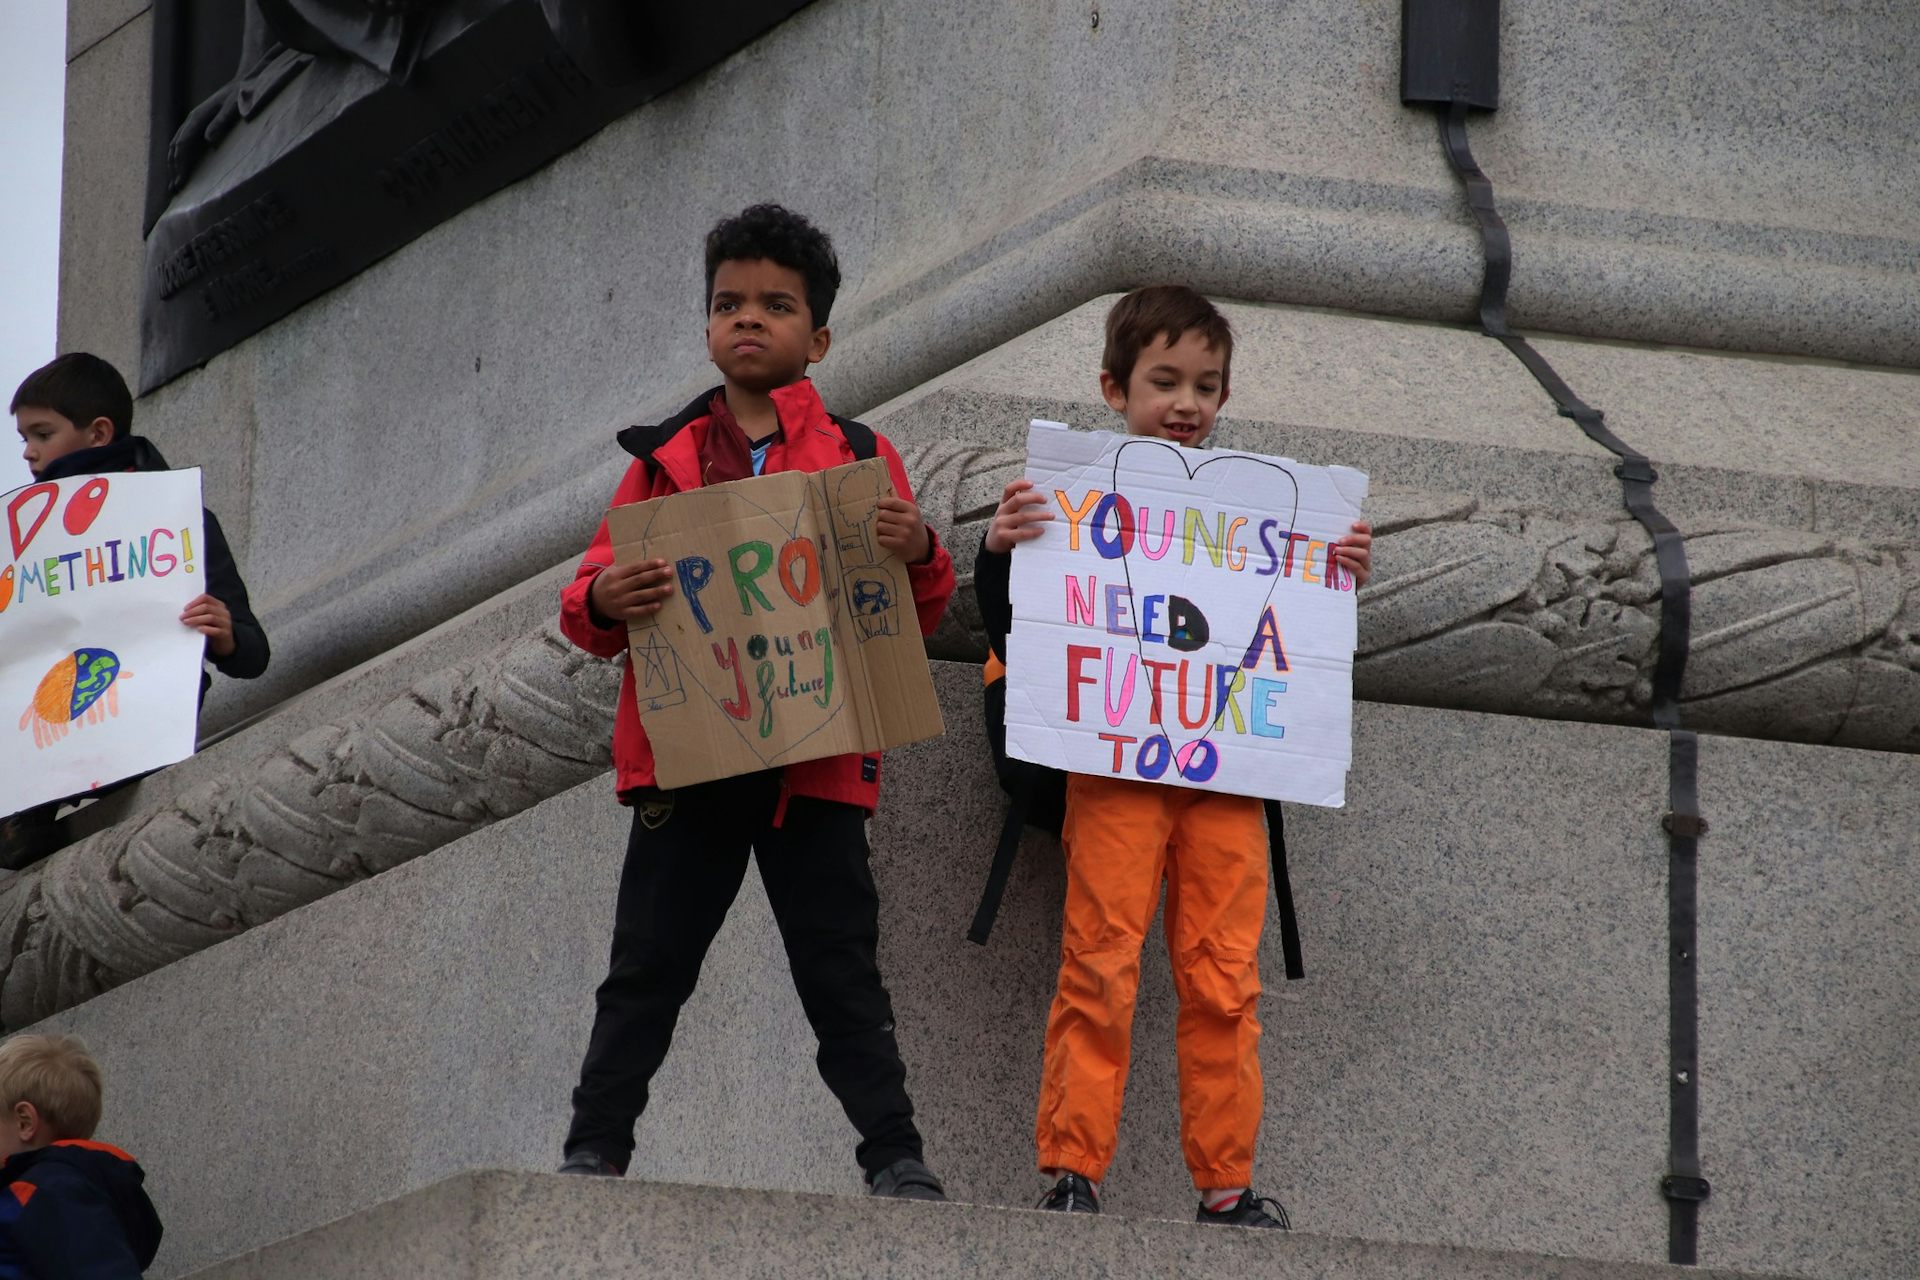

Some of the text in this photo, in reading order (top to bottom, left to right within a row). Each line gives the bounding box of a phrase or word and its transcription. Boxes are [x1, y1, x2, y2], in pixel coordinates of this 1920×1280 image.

[7, 477, 109, 561] DO
[1054, 489, 1353, 592] YOUNGSTERS
[675, 535, 822, 634] PRO
[1065, 575, 1293, 672] NEED A
[711, 627, 834, 721] young
[1065, 644, 1288, 739] FUTURE
[1097, 733, 1222, 783] TOO
